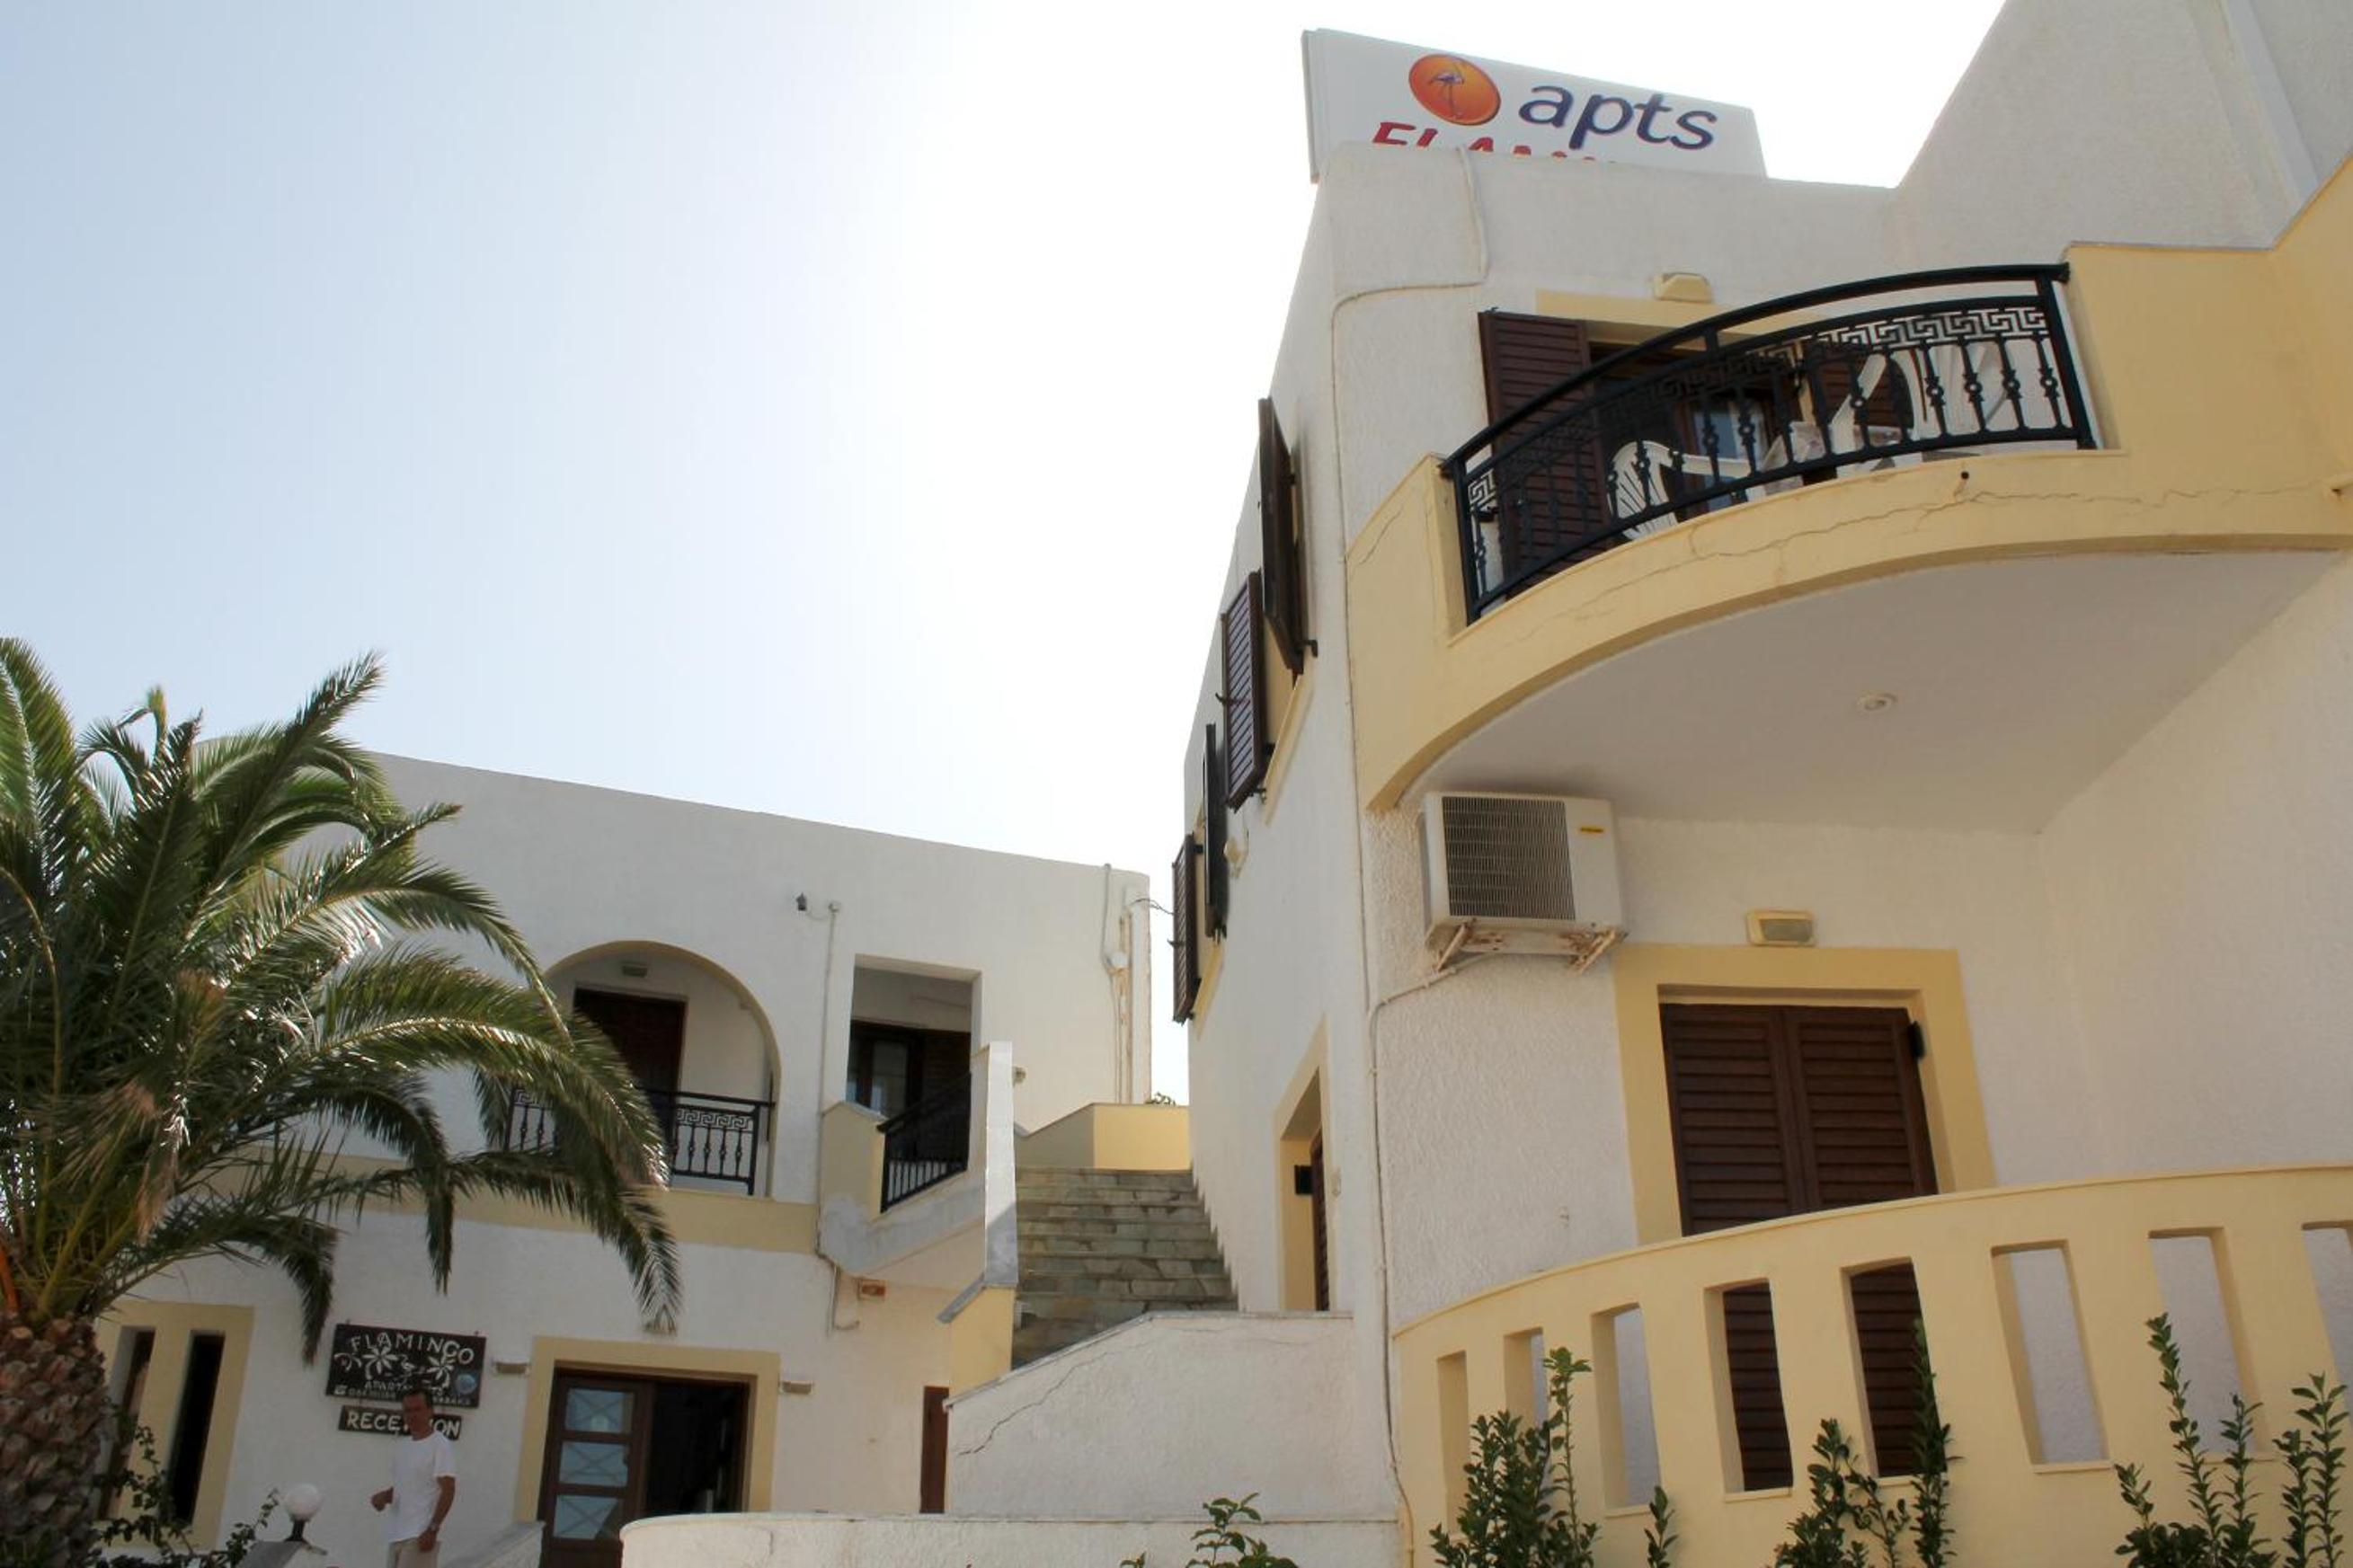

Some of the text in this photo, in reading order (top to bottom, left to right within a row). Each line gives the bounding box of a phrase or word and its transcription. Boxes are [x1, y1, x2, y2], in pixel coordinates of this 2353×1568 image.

[1517, 84, 1718, 150] apts
[350, 1332, 475, 1364] FLAMINGO
[347, 1410, 460, 1439] RECEON
